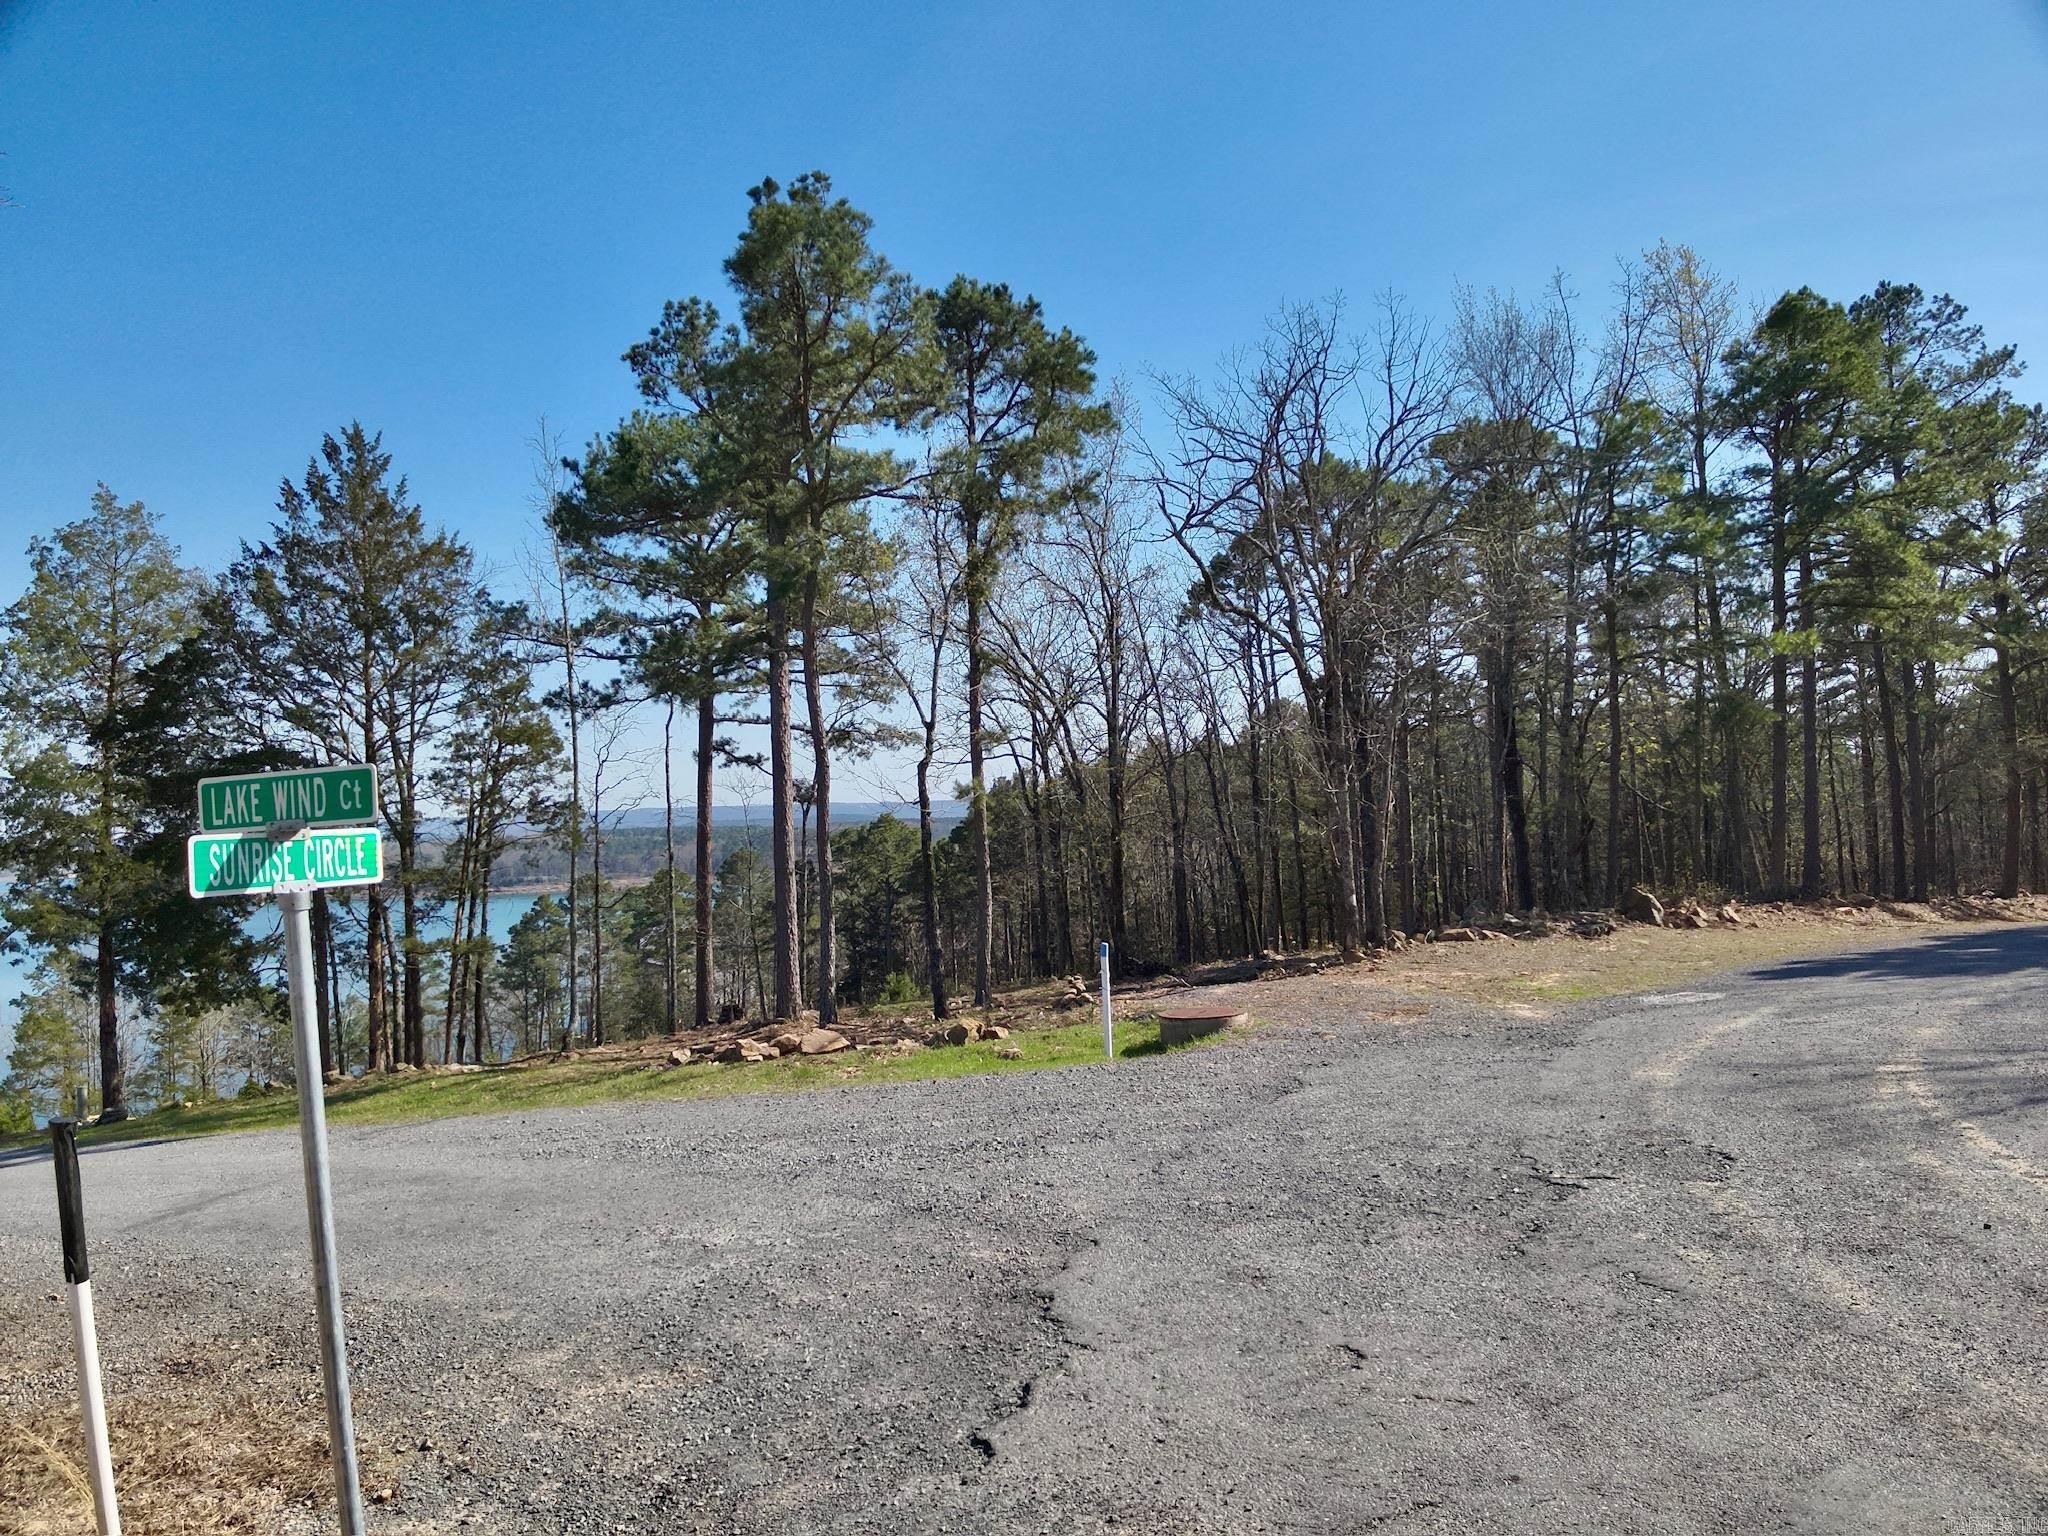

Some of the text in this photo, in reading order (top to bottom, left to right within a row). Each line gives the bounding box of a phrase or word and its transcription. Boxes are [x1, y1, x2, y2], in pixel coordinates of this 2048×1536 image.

[211, 777, 362, 825] LAKE WIND Ct
[209, 837, 368, 887] SUNRISE CIRCLE
